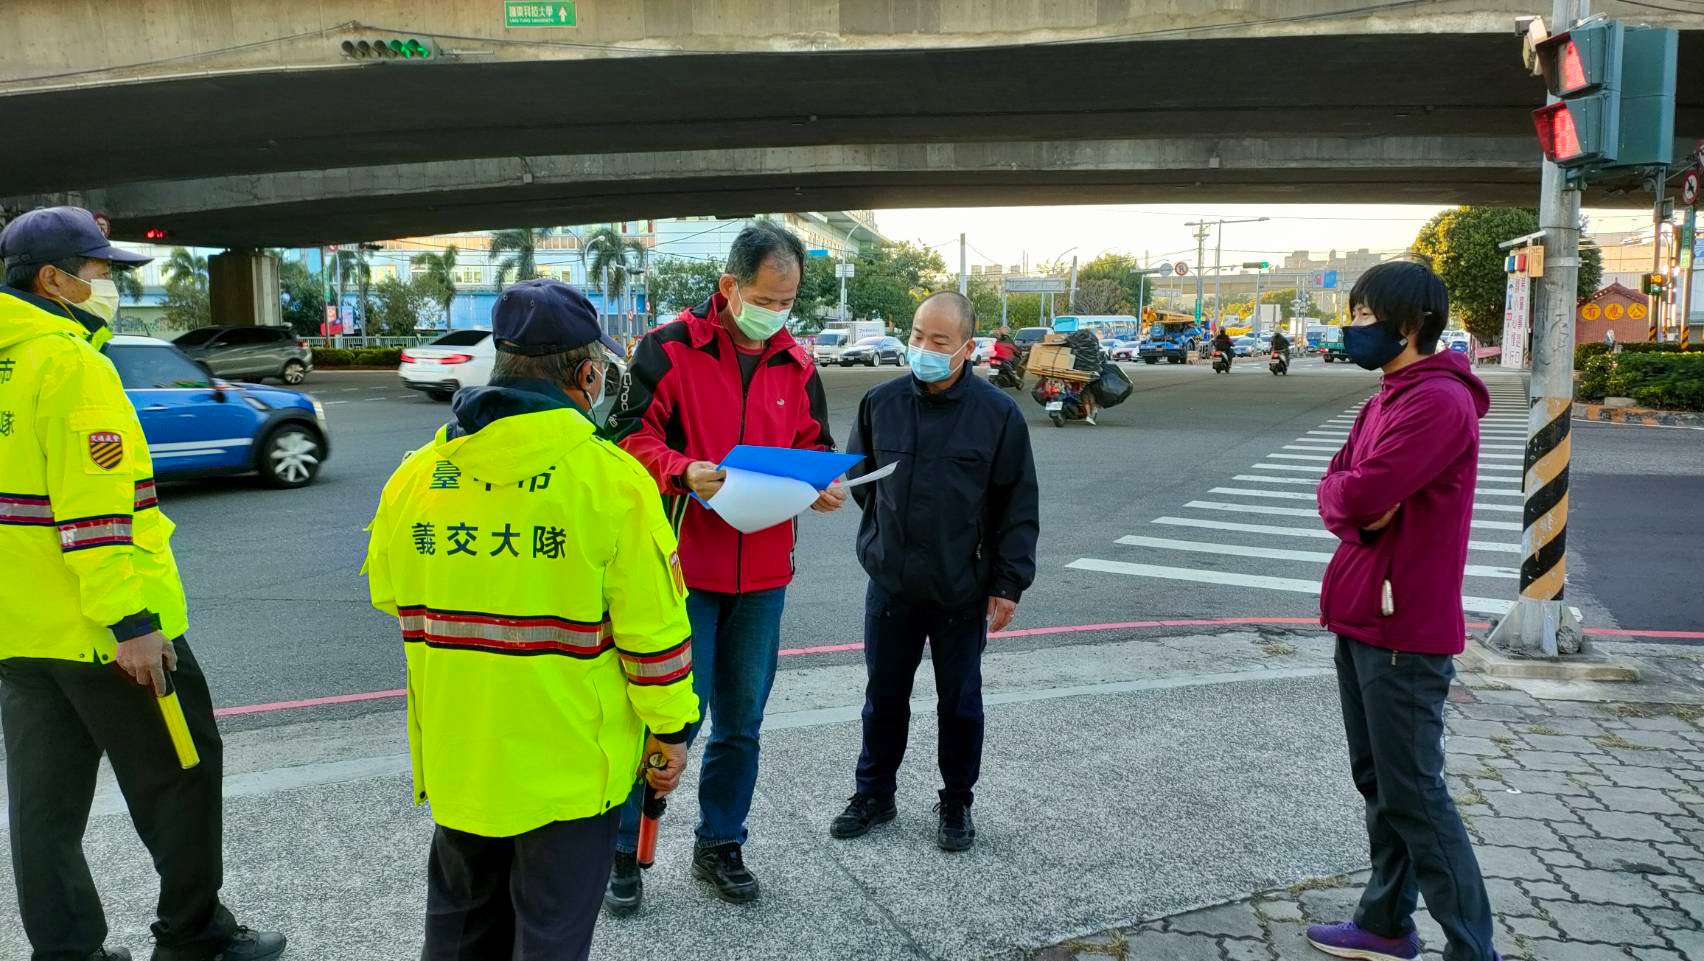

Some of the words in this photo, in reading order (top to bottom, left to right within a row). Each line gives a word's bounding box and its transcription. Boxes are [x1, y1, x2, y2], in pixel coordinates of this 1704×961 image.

[429, 460, 557, 492] 臺市
[411, 522, 567, 559] 義交大隊
